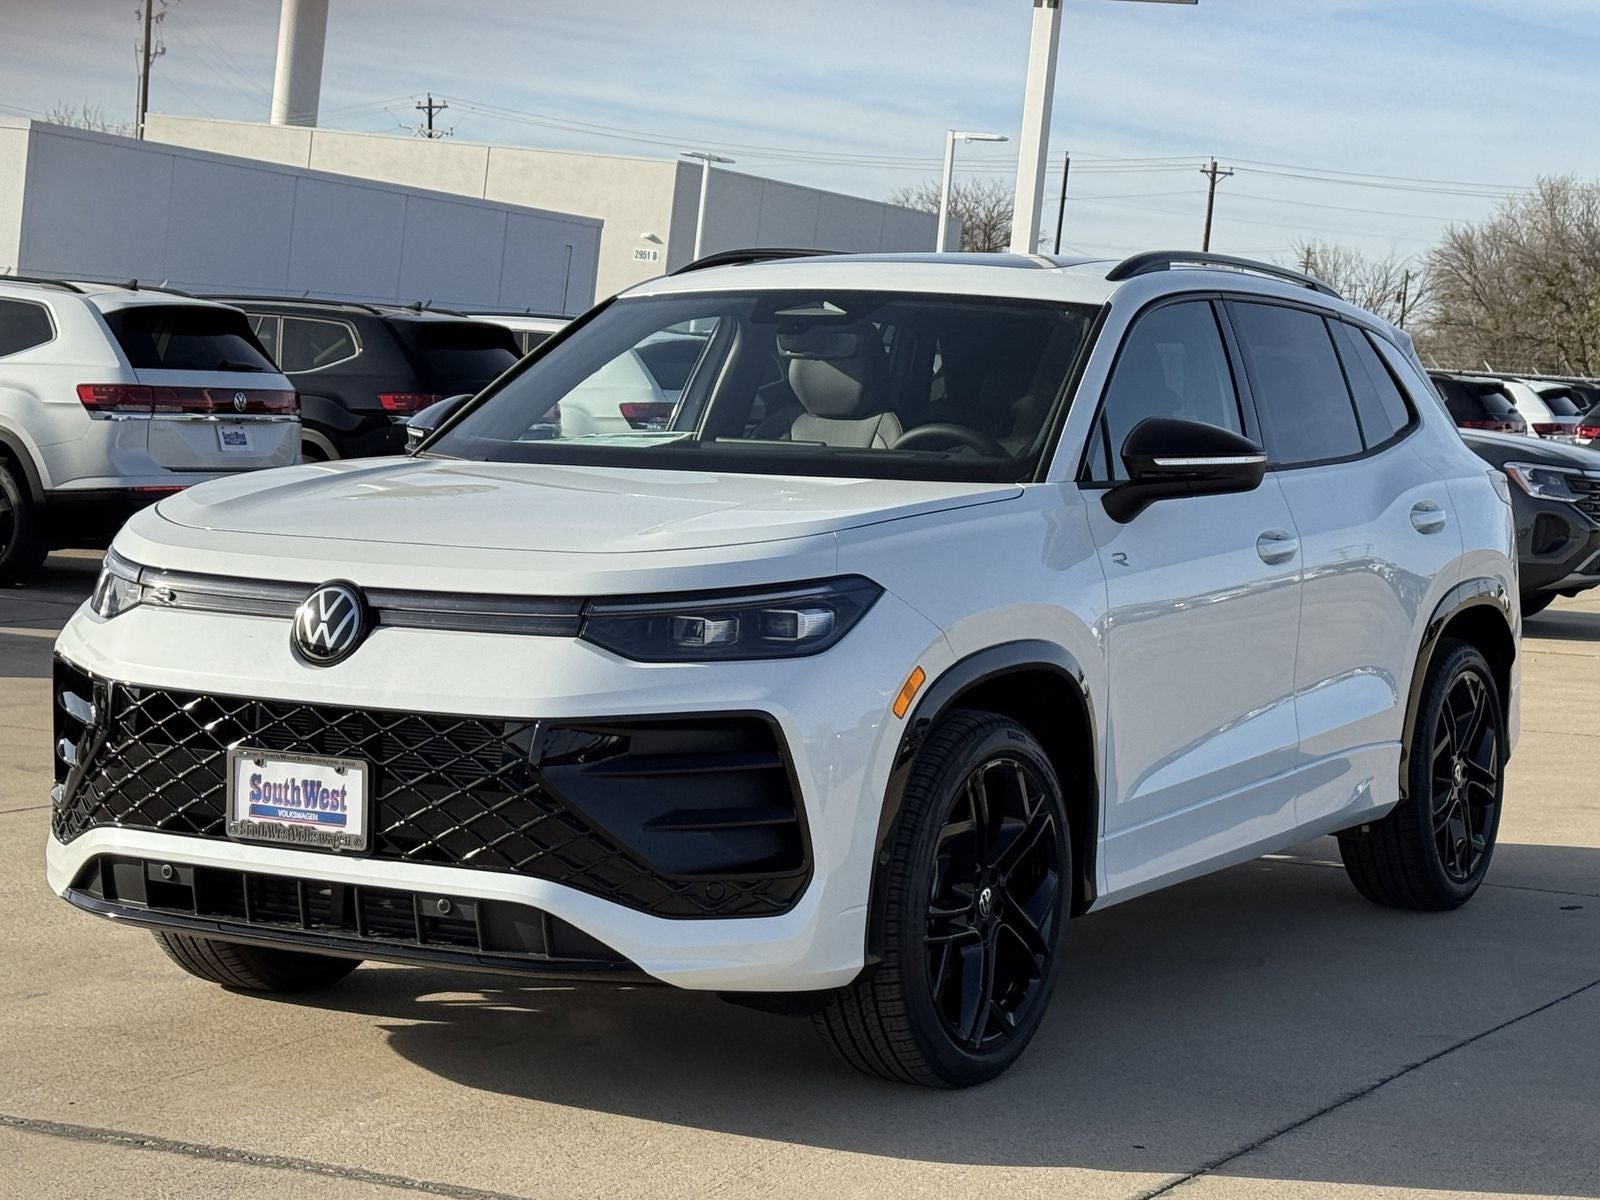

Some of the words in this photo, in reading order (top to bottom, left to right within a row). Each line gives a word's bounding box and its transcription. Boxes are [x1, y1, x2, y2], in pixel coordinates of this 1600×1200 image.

[634, 249, 651, 260] 2951
[297, 587, 358, 655] VW
[249, 773, 348, 813] SouthWest
[277, 808, 319, 821] VOLKSWAGEN
